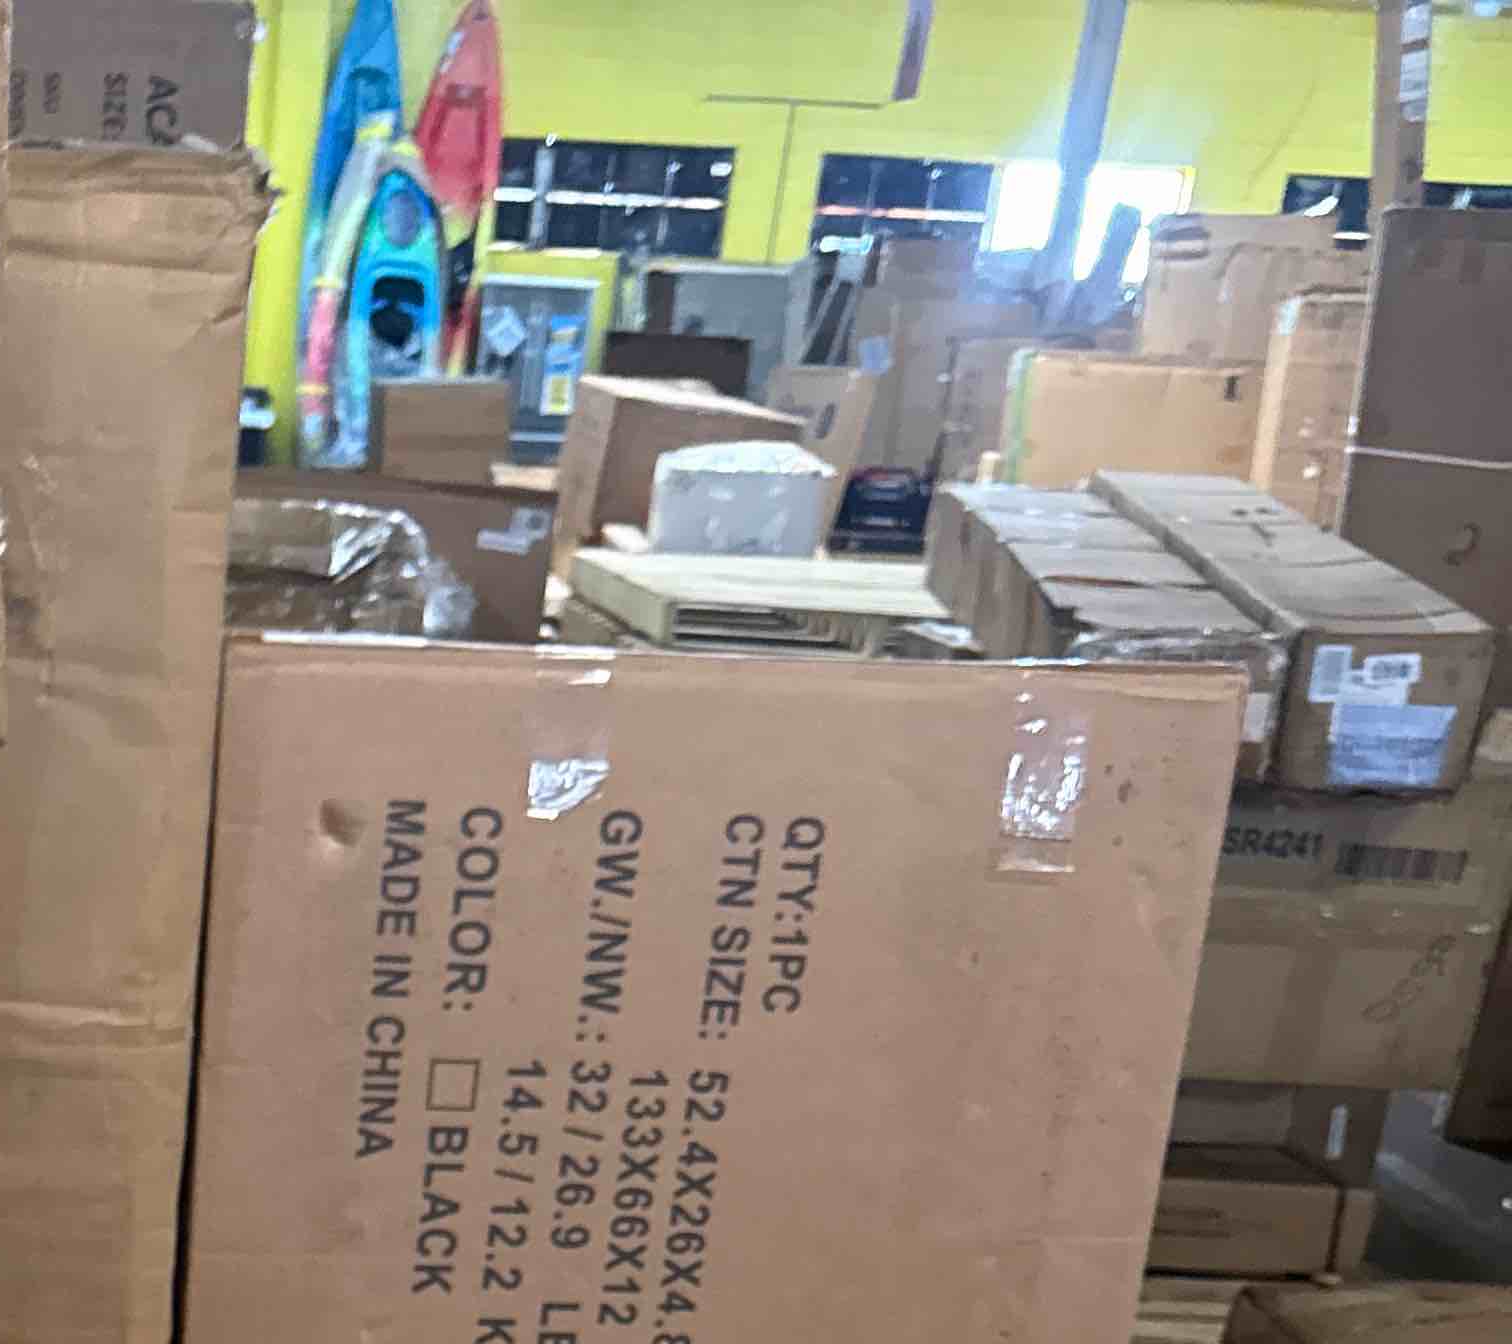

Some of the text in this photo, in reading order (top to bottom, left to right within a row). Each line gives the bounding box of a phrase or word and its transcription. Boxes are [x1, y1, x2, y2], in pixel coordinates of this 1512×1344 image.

[442, 807, 503, 1013] COLOR:
[715, 813, 766, 907] CTN
[762, 816, 826, 1014] QTY:1PC
[355, 800, 427, 1160] MADE IN CHINA
[697, 925, 752, 1041] SIZE:
[497, 1060, 546, 1160] 14.5
[567, 1061, 612, 1121] 32
[411, 1125, 470, 1296] BLACK
[480, 1199, 530, 1293] 12.2
[550, 1153, 599, 1250] 26.9
[596, 1070, 668, 1326] 133X66X12
